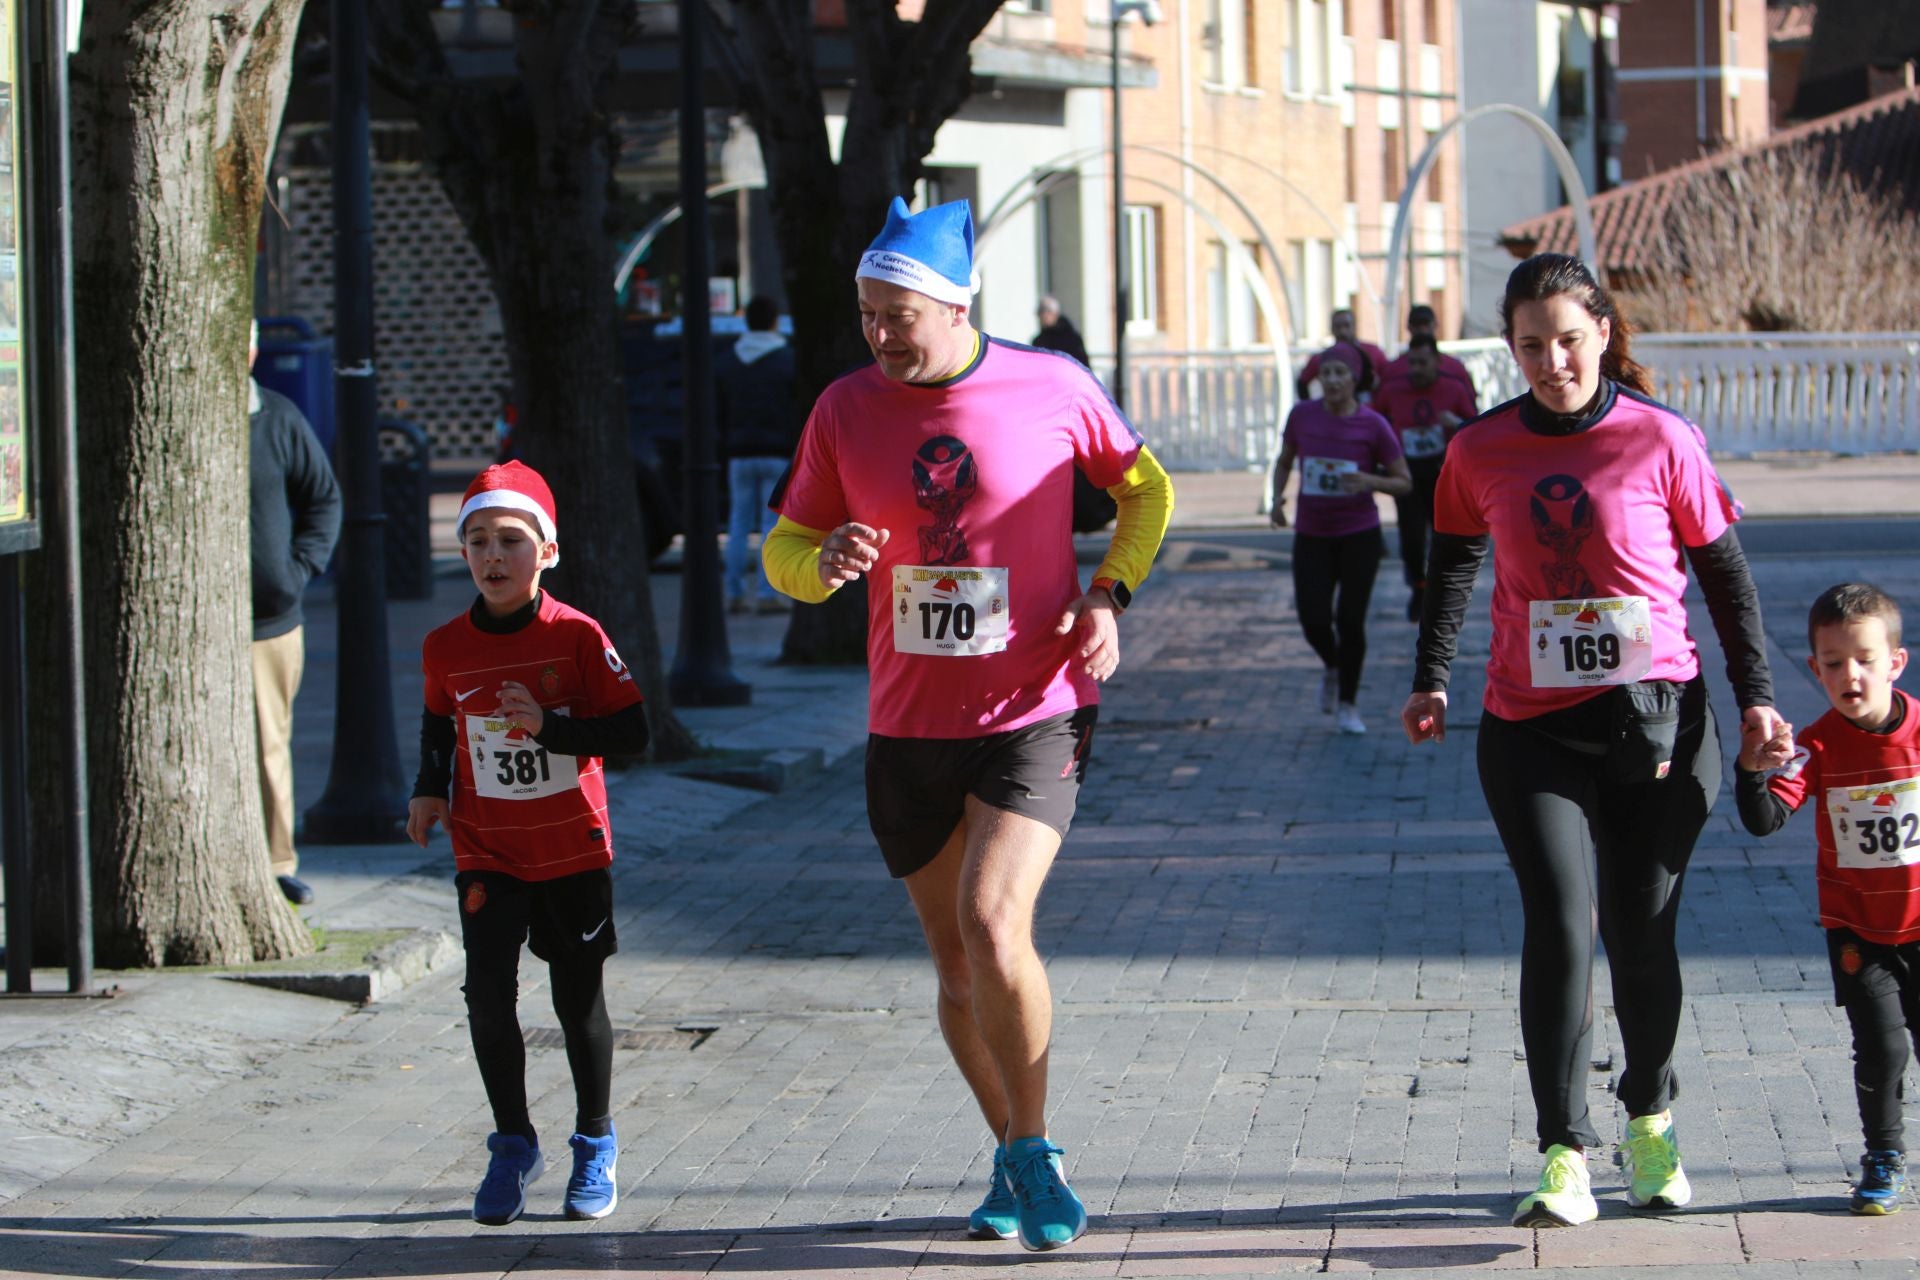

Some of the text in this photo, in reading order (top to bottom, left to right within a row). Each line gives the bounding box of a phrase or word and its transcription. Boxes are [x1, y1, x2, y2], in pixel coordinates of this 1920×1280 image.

[875, 262, 923, 283] Nochebuena
[883, 254, 914, 269] Carrera
[918, 602, 975, 641] 170
[1559, 633, 1621, 672] 169
[494, 747, 550, 785] 381
[1855, 812, 1920, 855] 382
